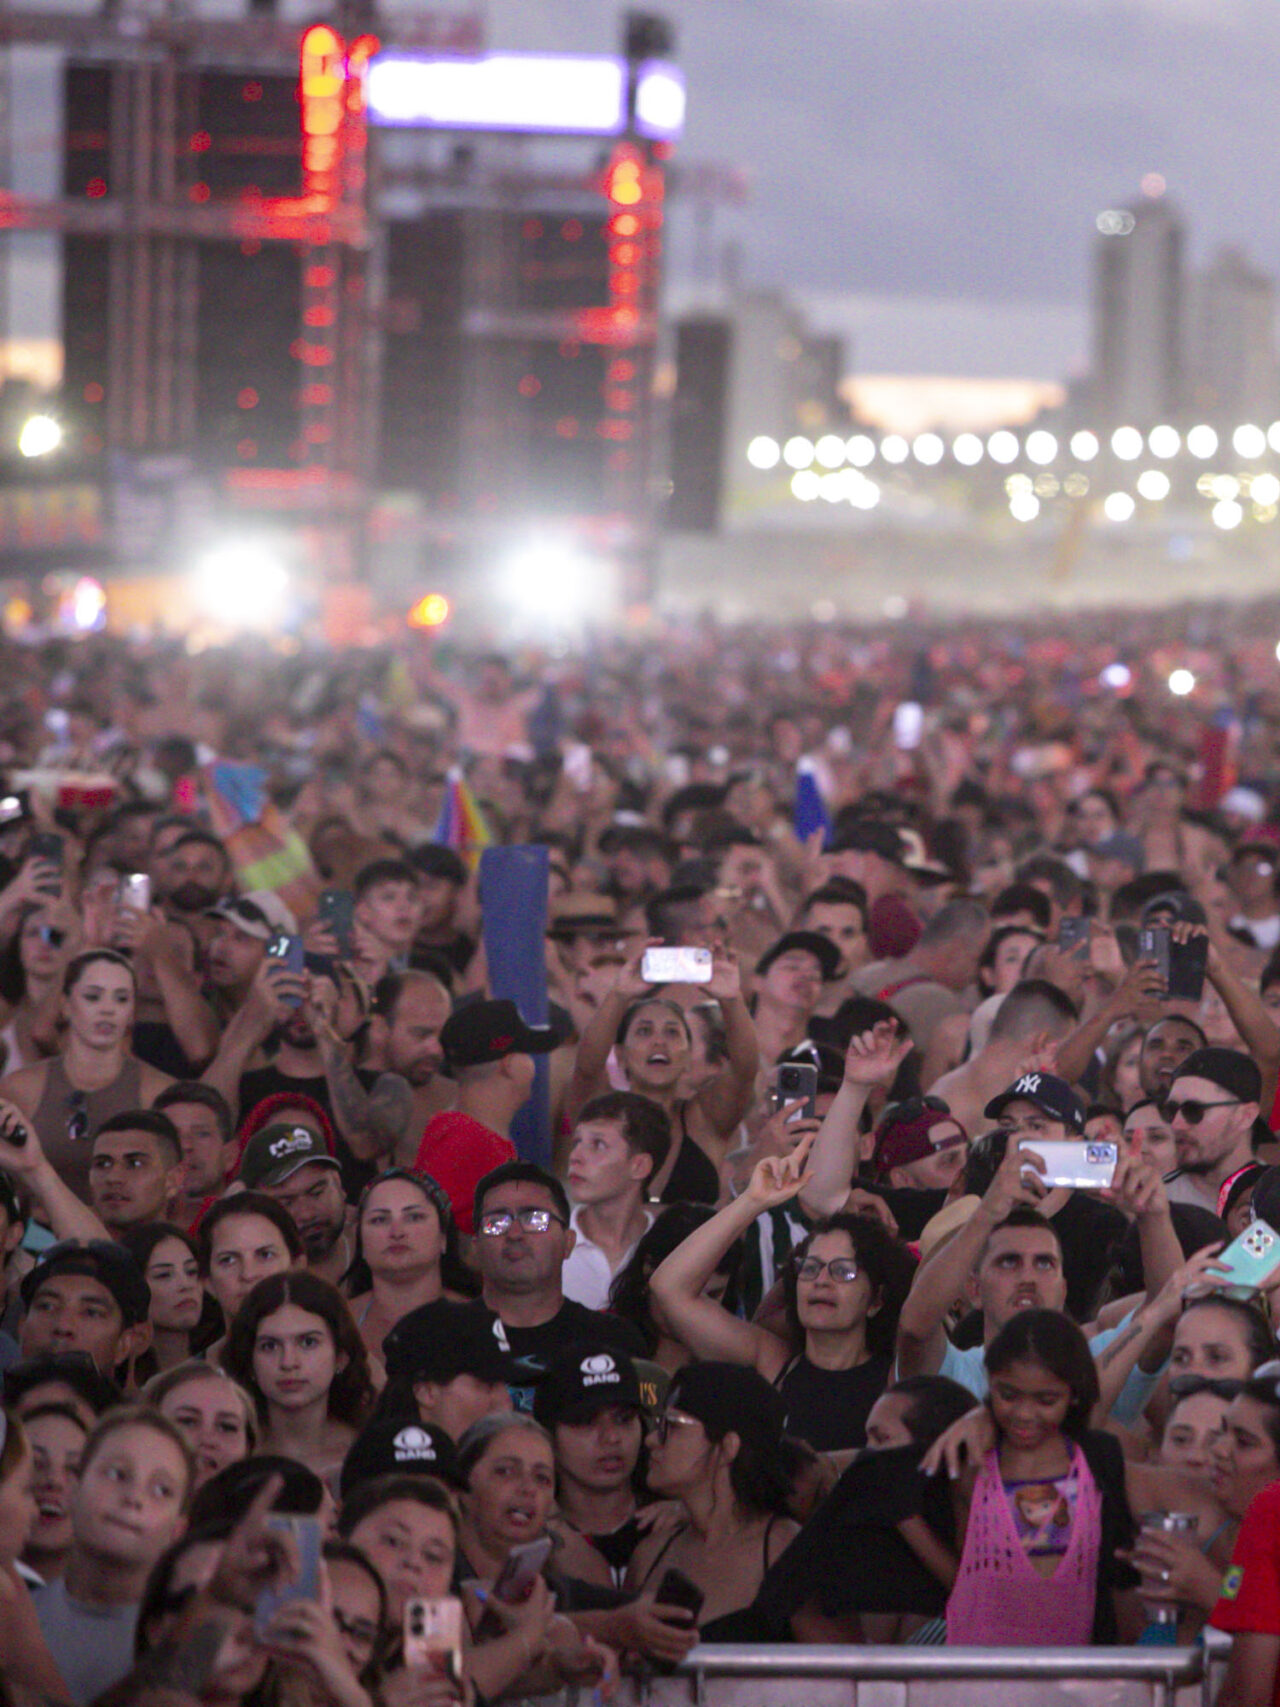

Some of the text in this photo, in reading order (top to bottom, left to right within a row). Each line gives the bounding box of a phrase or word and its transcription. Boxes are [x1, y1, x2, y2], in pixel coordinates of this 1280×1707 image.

[1015, 1074, 1042, 1093] NY
[583, 1371, 620, 1387] BAND
[395, 1448, 437, 1461] BAND
